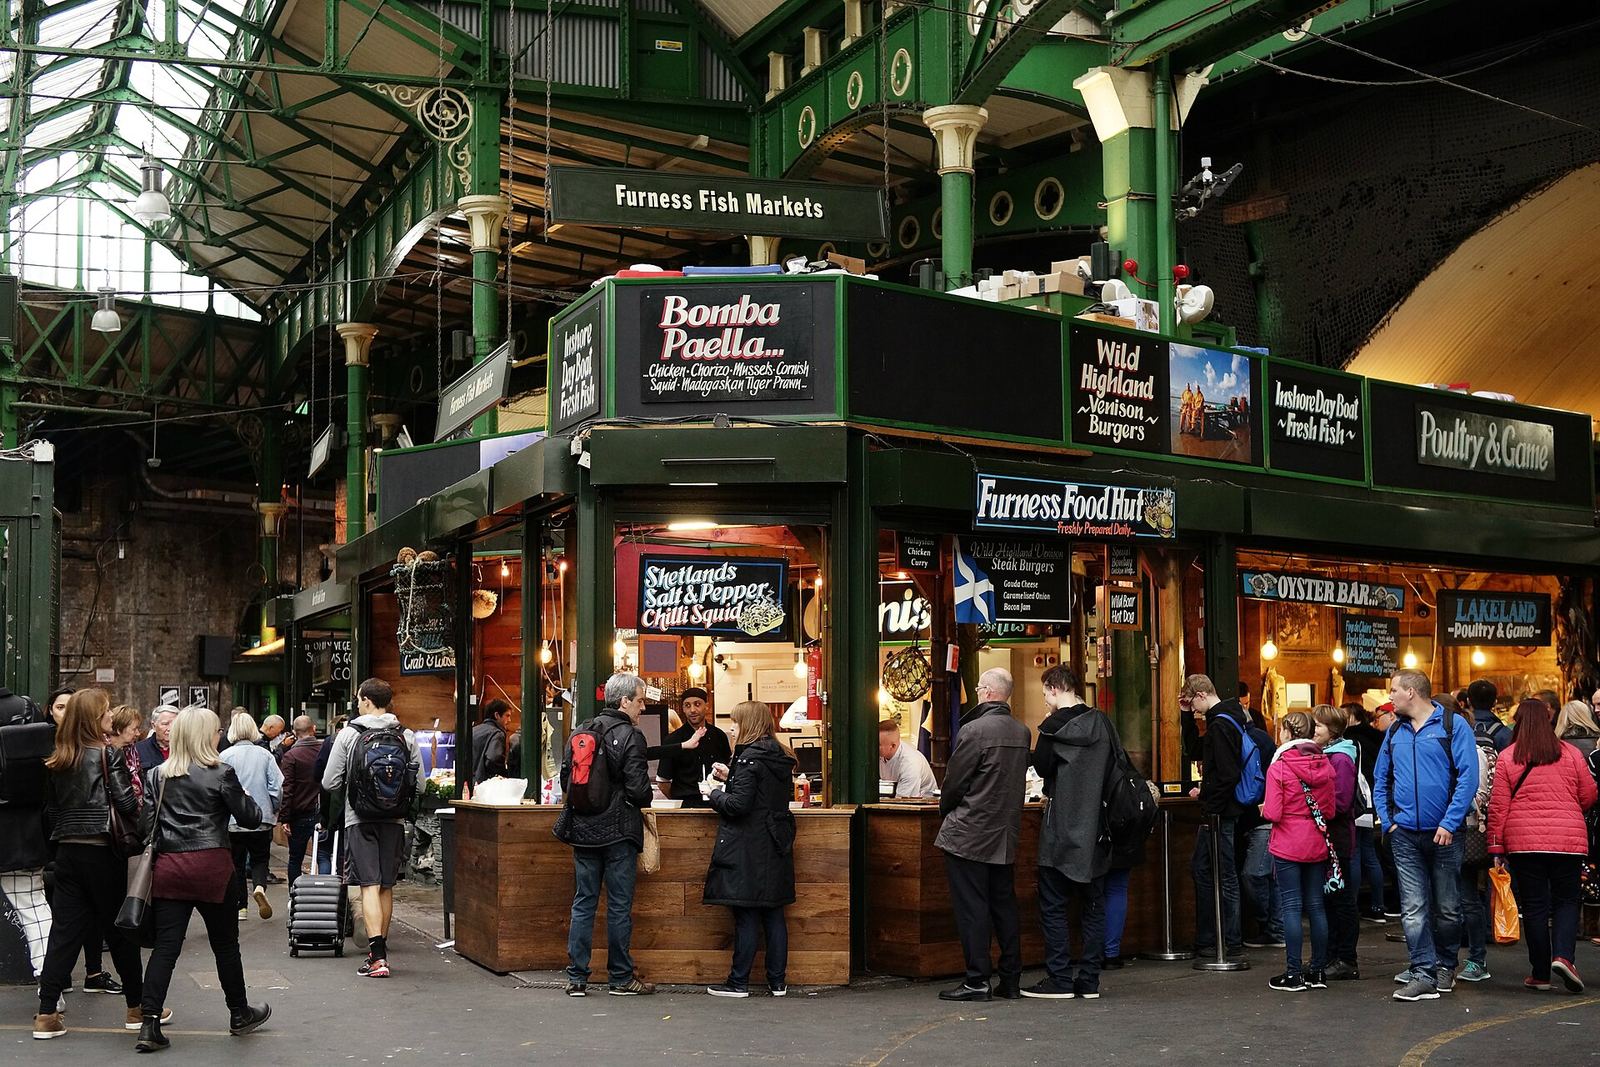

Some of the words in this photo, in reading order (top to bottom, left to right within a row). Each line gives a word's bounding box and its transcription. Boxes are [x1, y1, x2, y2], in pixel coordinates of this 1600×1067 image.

[615, 184, 692, 212] Furness
[698, 190, 739, 214] Fish
[746, 193, 824, 219] Markets
[659, 294, 781, 328] Bomba
[564, 323, 592, 358] Inshore
[660, 327, 785, 361] Paella...
[1097, 338, 1140, 371] Wild
[561, 360, 576, 393] Day
[575, 346, 593, 382] Boat
[691, 362, 731, 377] Chorizo
[733, 361, 773, 377] Mussels
[776, 361, 809, 377] Cornish
[650, 377, 676, 395] Squid
[746, 376, 772, 396] Tiger
[1080, 363, 1154, 400] Highland
[560, 384, 580, 421] Fresh
[580, 375, 595, 412] Fish
[1275, 380, 1316, 413] Inshore
[1315, 389, 1338, 420] Day
[1336, 395, 1359, 421] Boat
[1421, 410, 1484, 470] Poultry
[1485, 422, 1501, 466] &
[1501, 425, 1549, 471] Game
[977, 479, 1061, 519] Furness
[1060, 485, 1110, 520] Food
[1110, 486, 1145, 522] Hut
[1057, 521, 1083, 536] Freshly
[1084, 521, 1113, 536] Prepared
[903, 536, 935, 547] Malaysian
[907, 547, 931, 557] Chicken
[970, 541, 994, 557] Wild
[995, 542, 1033, 559] Highland
[1034, 543, 1064, 559] Venison
[911, 557, 929, 569] Curry
[991, 557, 1018, 572] Steak
[1019, 558, 1055, 575] Burgers
[645, 562, 737, 589] Shetlands
[1003, 579, 1020, 588] Gouda
[1021, 580, 1039, 589] Cheese
[645, 586, 683, 609] Salt
[683, 585, 700, 605] &
[700, 581, 770, 605] Pepper
[1003, 591, 1035, 600] Caramelised
[1035, 592, 1051, 600] Onion
[1277, 575, 1335, 602] OYSTER
[1003, 603, 1020, 611] Bacon
[1020, 603, 1031, 612] Jam
[1111, 594, 1123, 609] Wild
[1122, 595, 1136, 608] Boar
[1456, 599, 1537, 623] LAKELAND
[642, 606, 689, 632] Chilli
[691, 601, 743, 629] Squid
[1111, 610, 1122, 624] Hot
[1122, 609, 1135, 624] Dog
[1496, 624, 1505, 638] &
[404, 653, 424, 670] Crab
[426, 654, 434, 669] &
